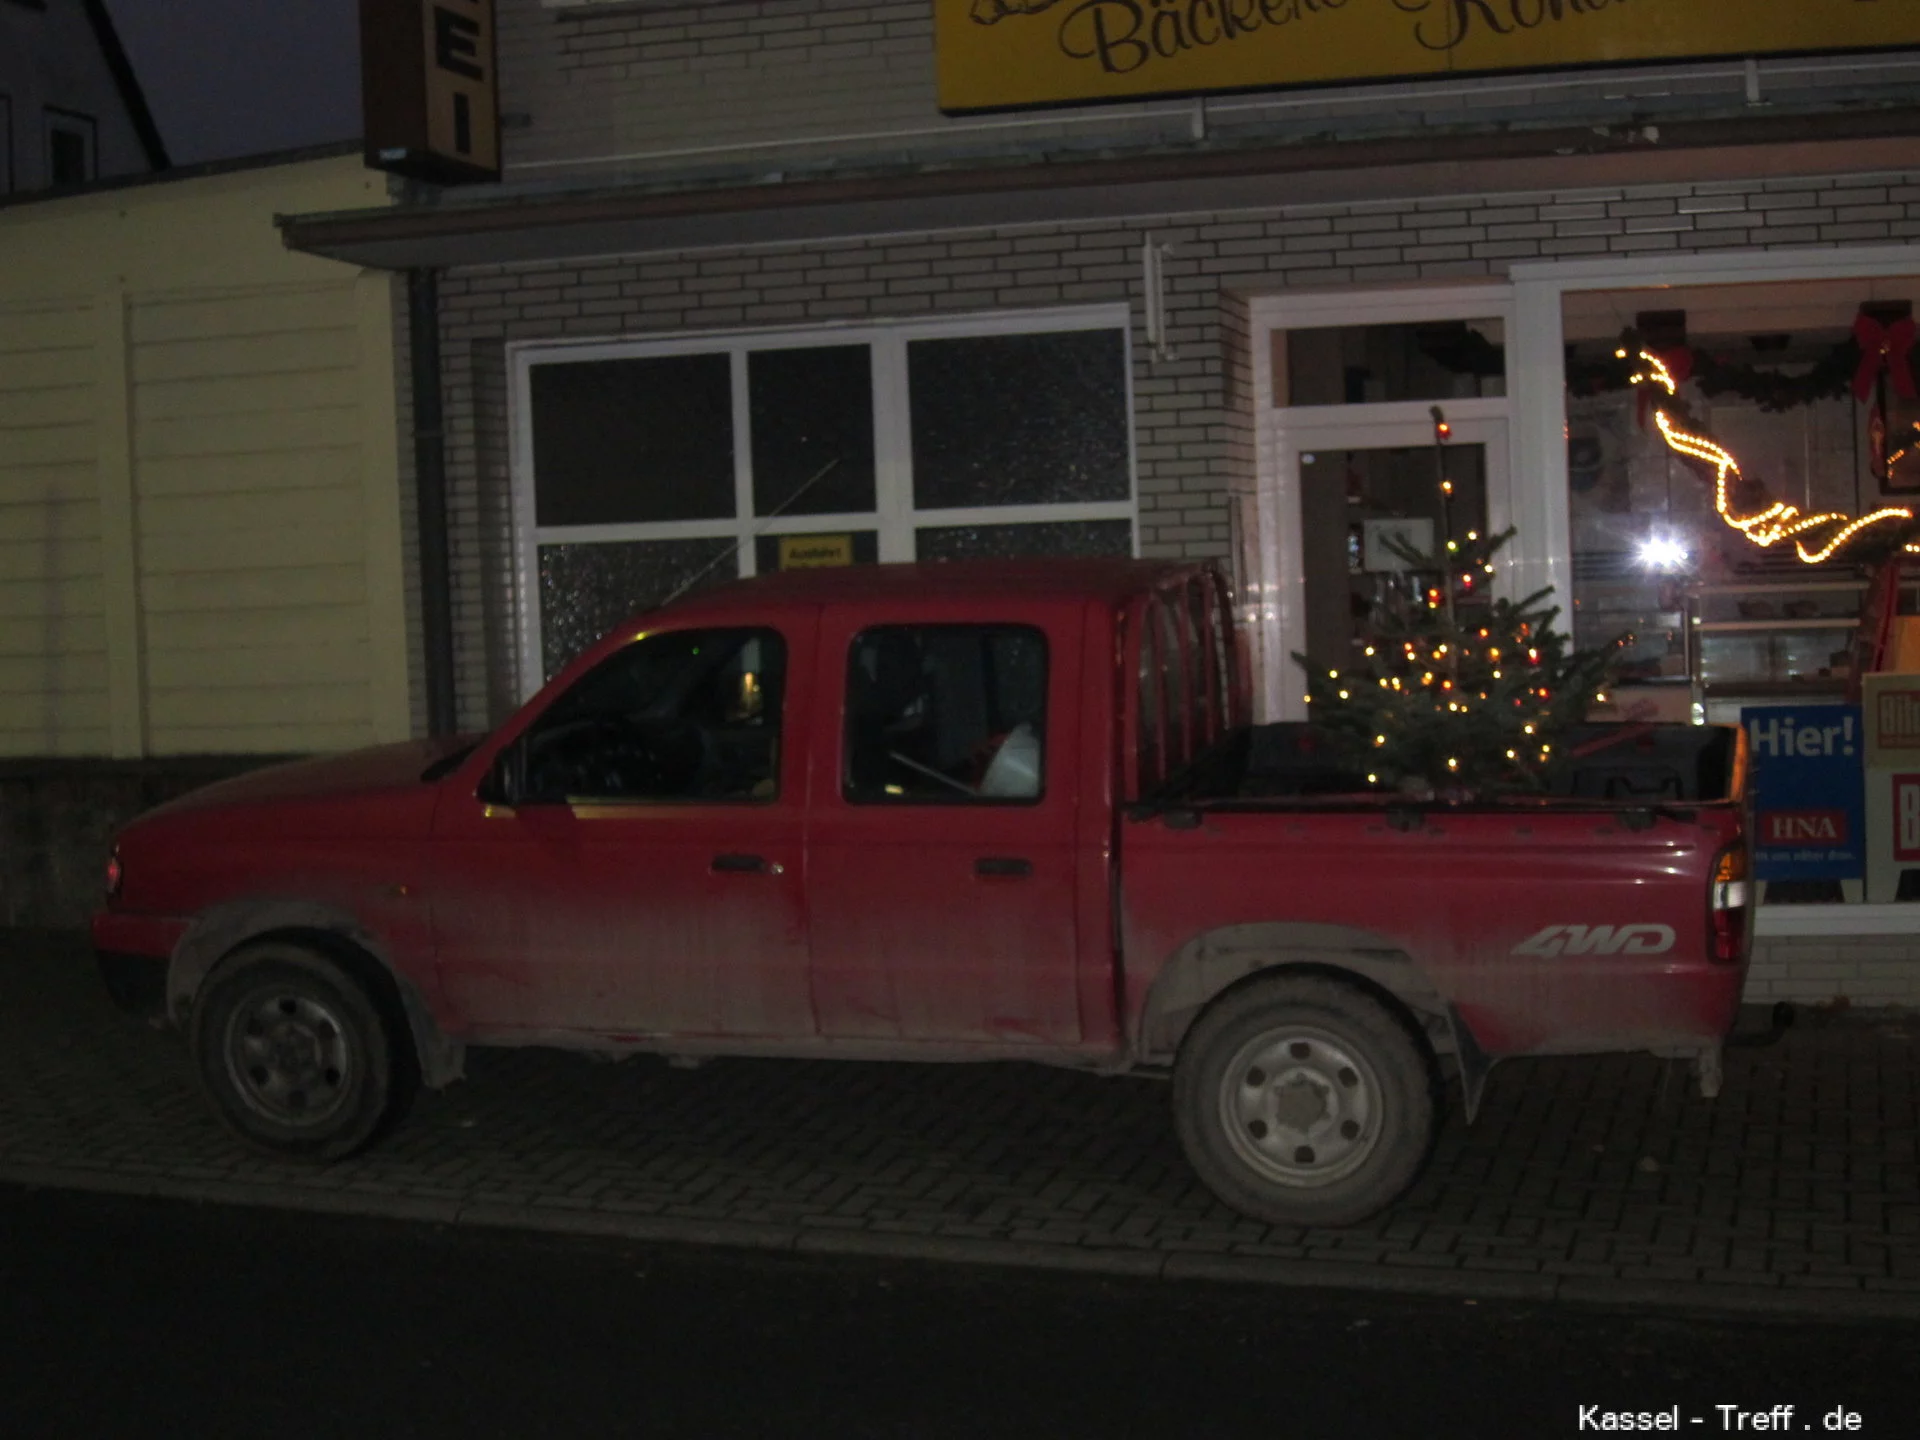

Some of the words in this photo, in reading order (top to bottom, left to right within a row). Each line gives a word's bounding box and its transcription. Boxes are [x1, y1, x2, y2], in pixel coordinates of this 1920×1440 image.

[1750, 716, 1854, 756] Hier!
[1772, 815, 1837, 840] HNA
[1510, 923, 1677, 957] 4WD
